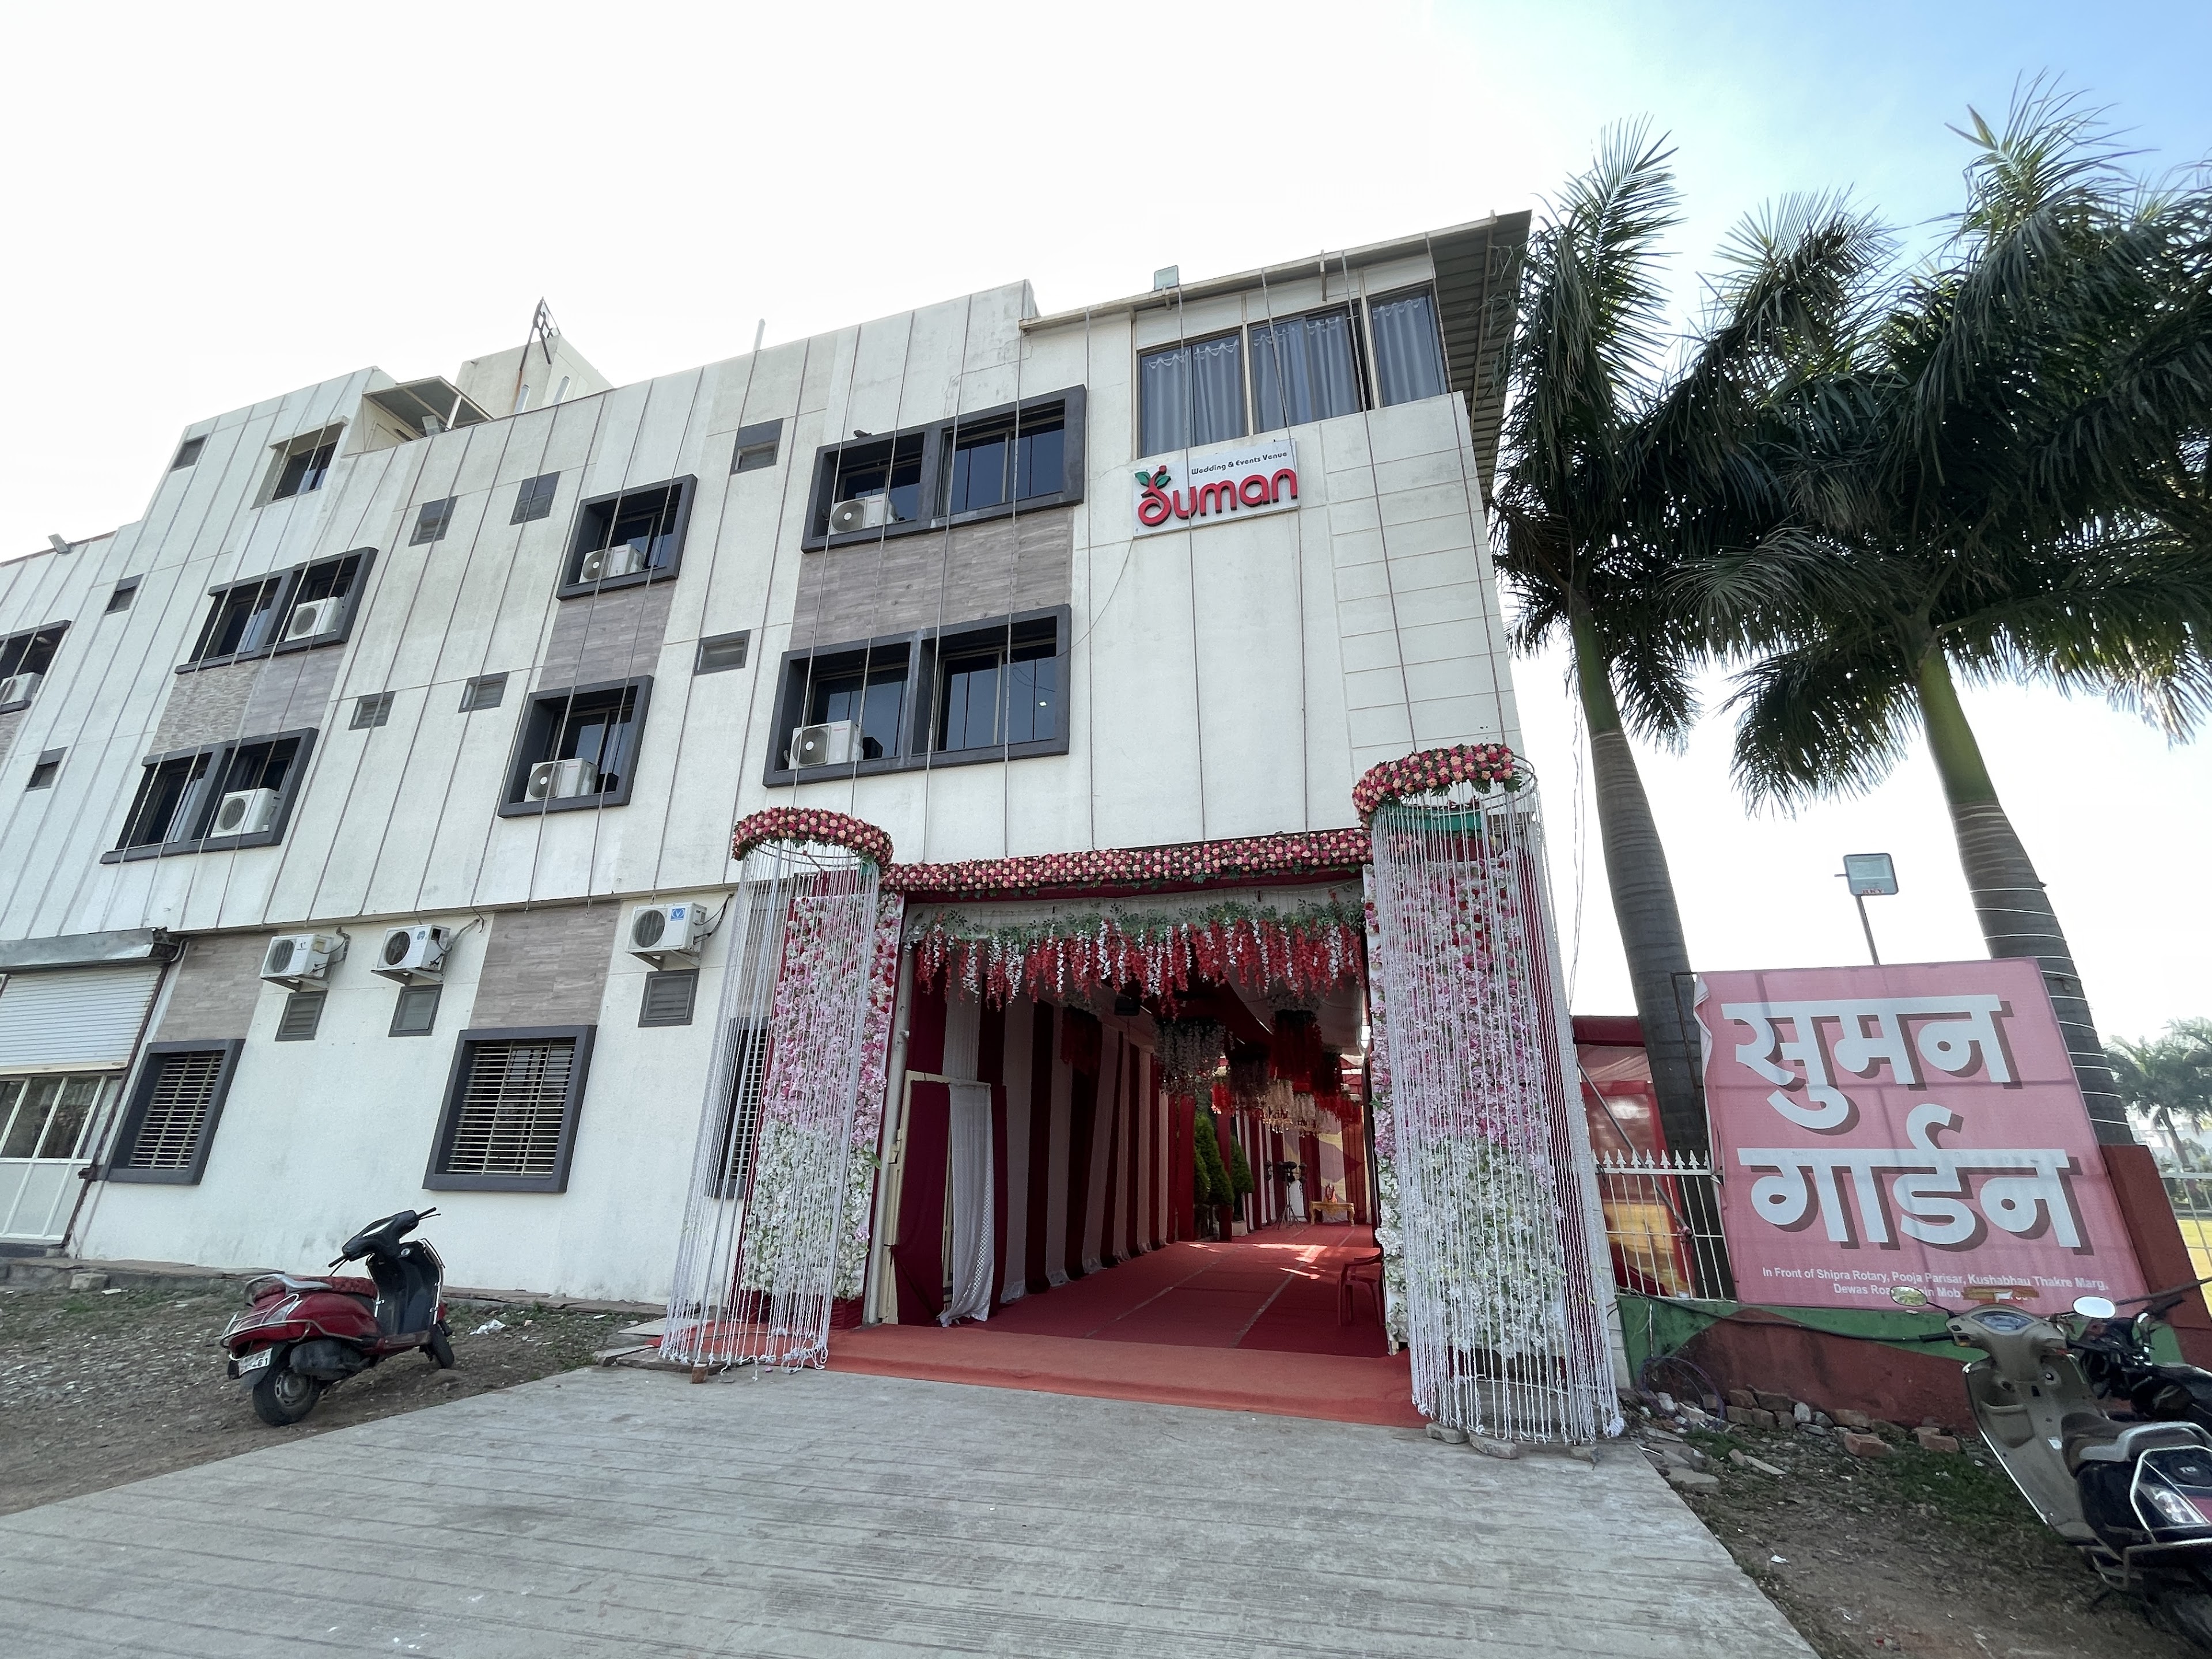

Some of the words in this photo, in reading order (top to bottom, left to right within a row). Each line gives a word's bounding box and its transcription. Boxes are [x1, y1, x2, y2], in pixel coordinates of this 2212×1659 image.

[1191, 464, 1226, 475] Wedding
[1236, 457, 1261, 466] Events
[1262, 452, 1287, 461] Venue
[1721, 994, 2012, 1130] सुमन
[1737, 1103, 2081, 1248] गार्डन
[1762, 1267, 1772, 1277] In
[1774, 1267, 1802, 1278] Front
[1804, 1268, 1815, 1278] of
[1816, 1268, 1850, 1281] Shipra
[1852, 1270, 1890, 1283] Rotary,
[1891, 1271, 1923, 1284] Pooja
[1925, 1272, 1967, 1285] Parisar,
[1968, 1273, 2031, 1286] Kushabhau
[2032, 1275, 2073, 1287] Thakre
[1834, 1283, 1868, 1294] Dewas
[1870, 1284, 1891, 1296] Roa
